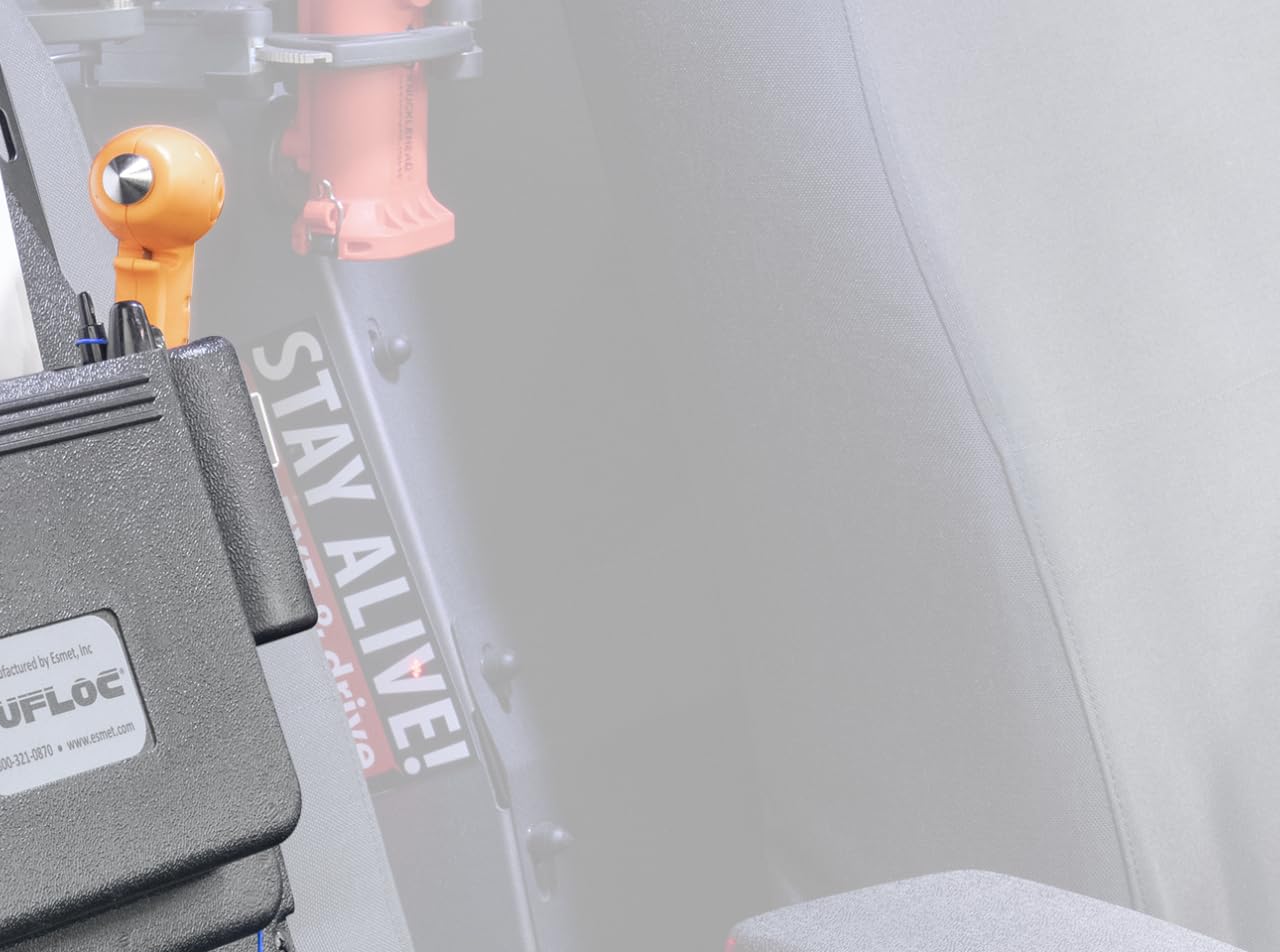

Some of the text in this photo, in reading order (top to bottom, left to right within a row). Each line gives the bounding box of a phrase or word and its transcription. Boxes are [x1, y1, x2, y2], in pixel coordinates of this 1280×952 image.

[252, 330, 470, 776] STAY ALIVE!
[39, 654, 50, 671] by
[50, 647, 80, 665] Esmet,
[67, 721, 136, 751] www.esmet.com
